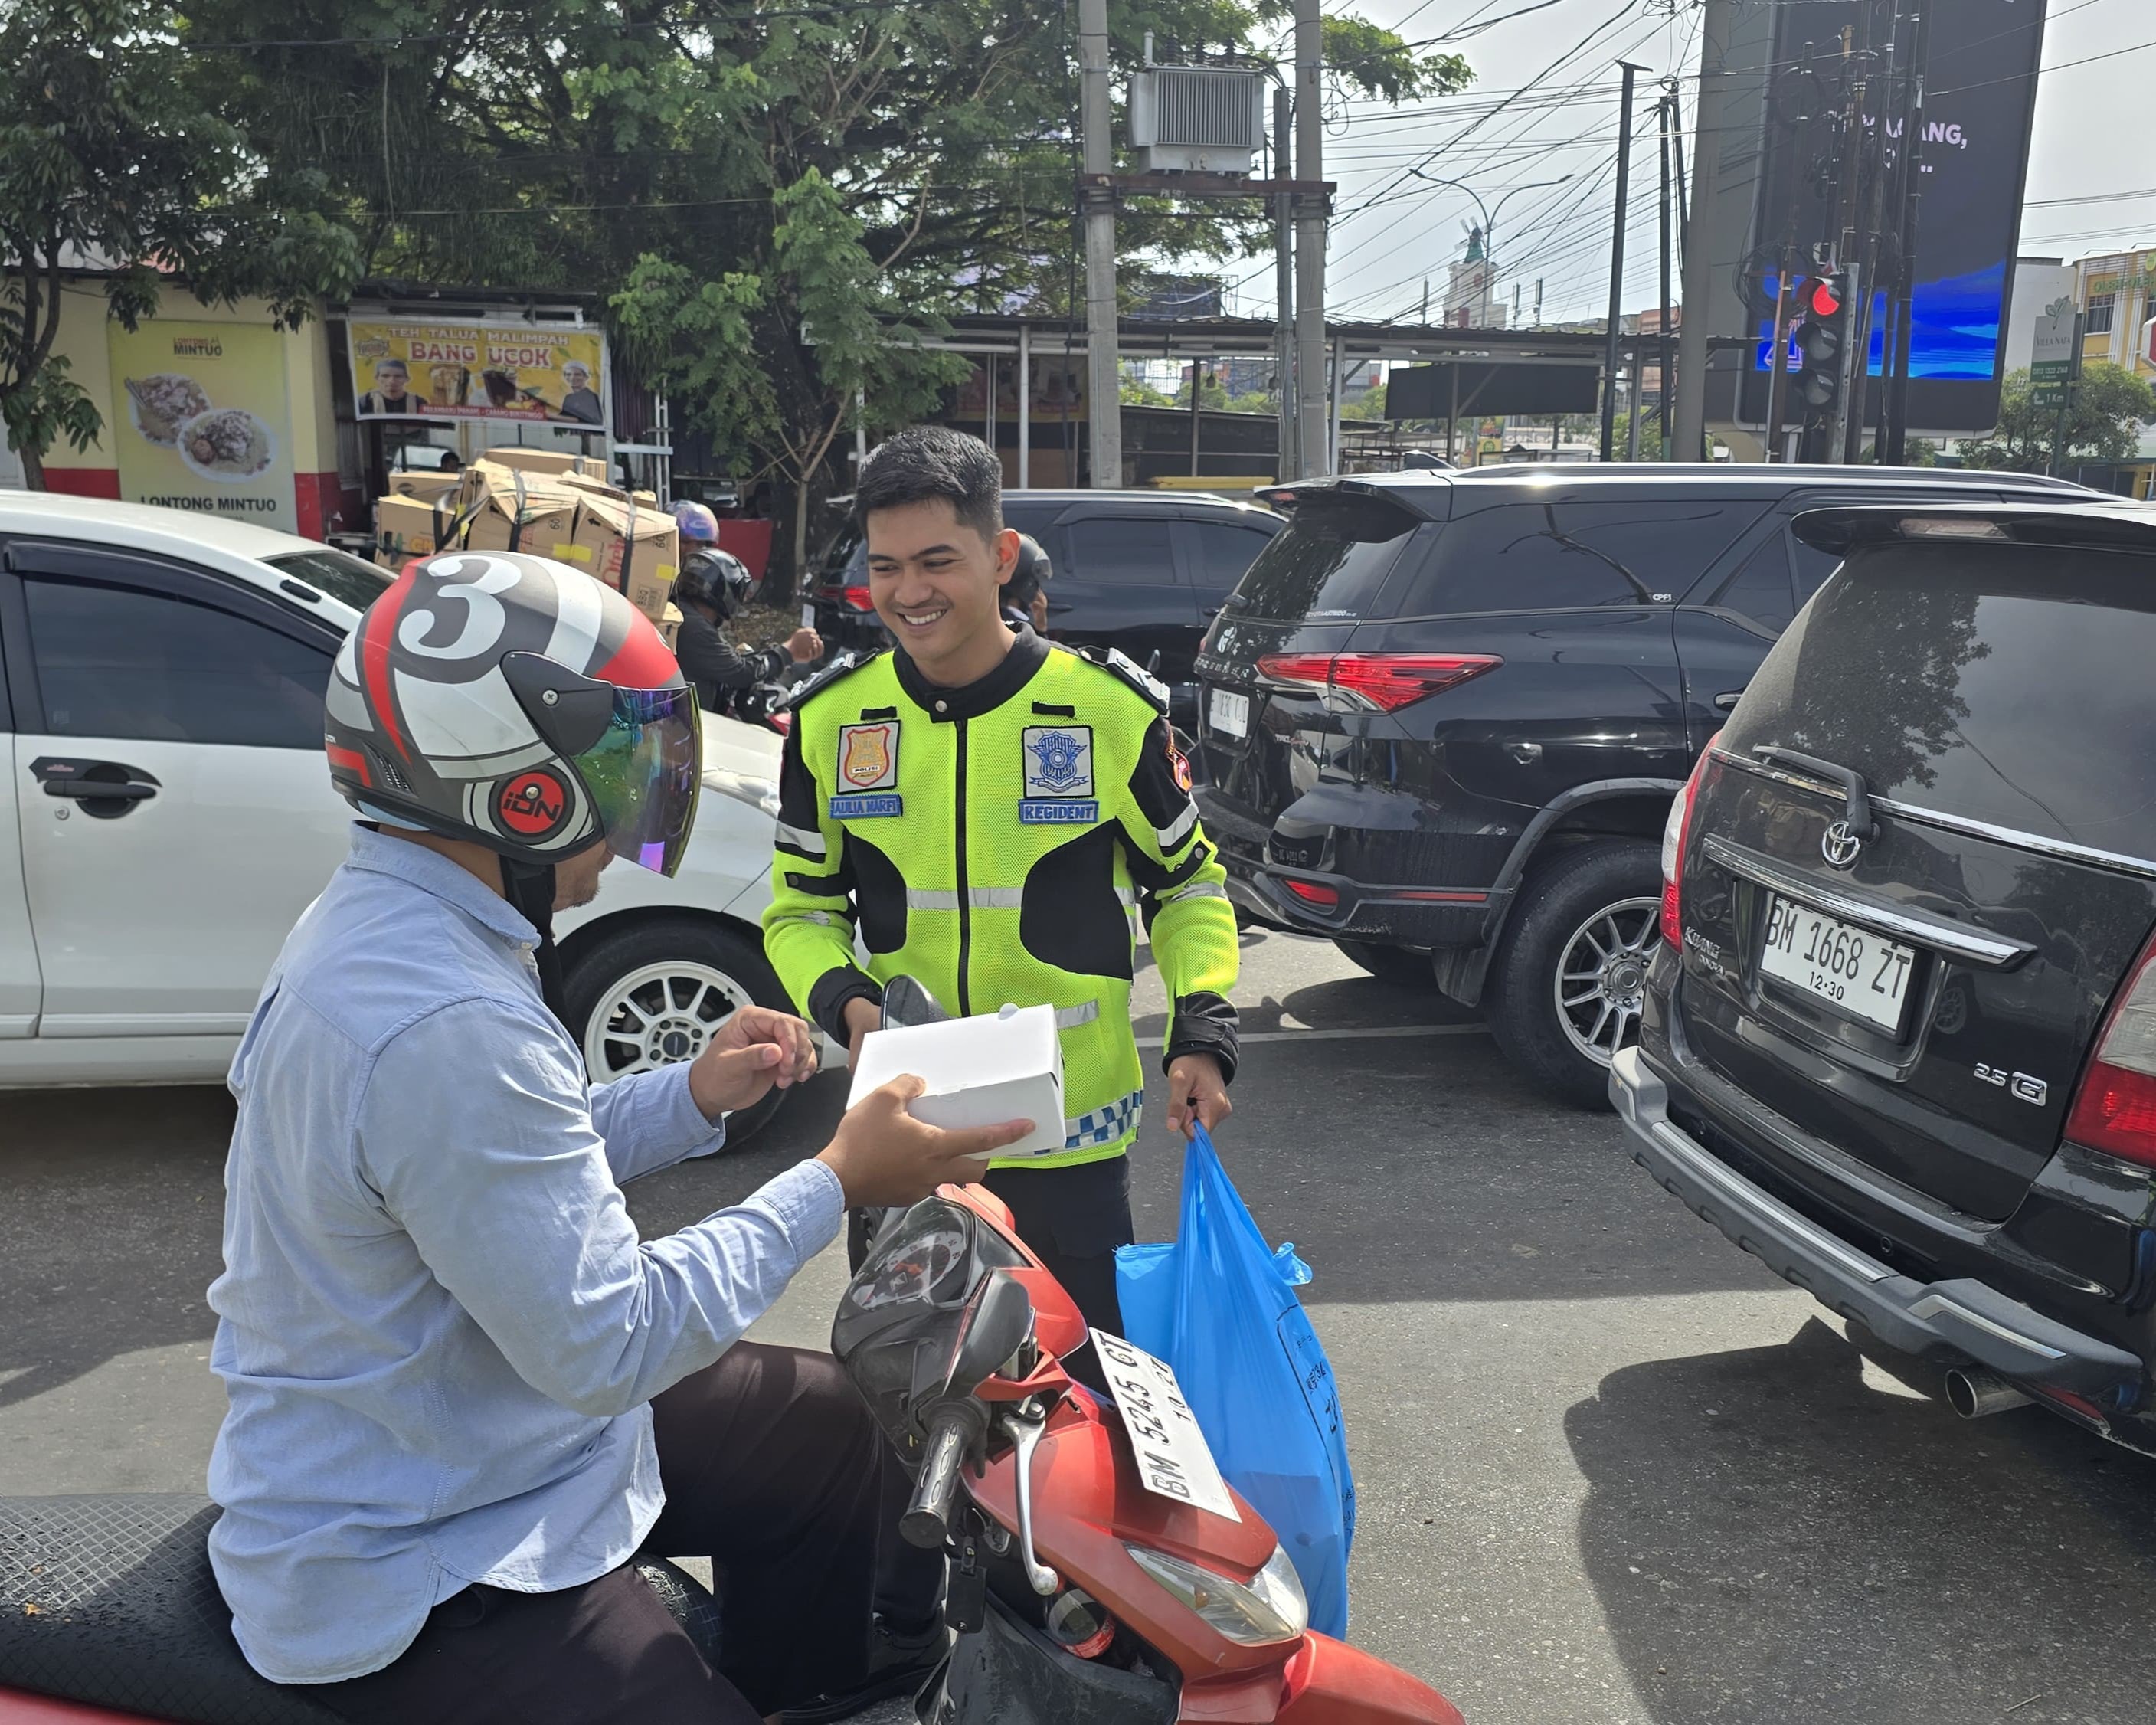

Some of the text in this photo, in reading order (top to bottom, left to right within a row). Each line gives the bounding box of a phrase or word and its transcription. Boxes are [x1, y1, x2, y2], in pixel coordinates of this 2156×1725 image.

[388, 327, 569, 345] TEH TALUA MALIMPAH
[173, 345, 223, 356] MINTUO
[408, 342, 477, 363] BANG
[487, 347, 553, 368] UCOK
[2046, 393, 2065, 403] 1 Km
[218, 496, 276, 512] MINTUO
[398, 555, 522, 660] 3
[1023, 805, 1094, 820] REGIDENT
[1766, 902, 1911, 999] BM 1668 ZT
[1097, 1331, 1191, 1499] BM 5245 GT
